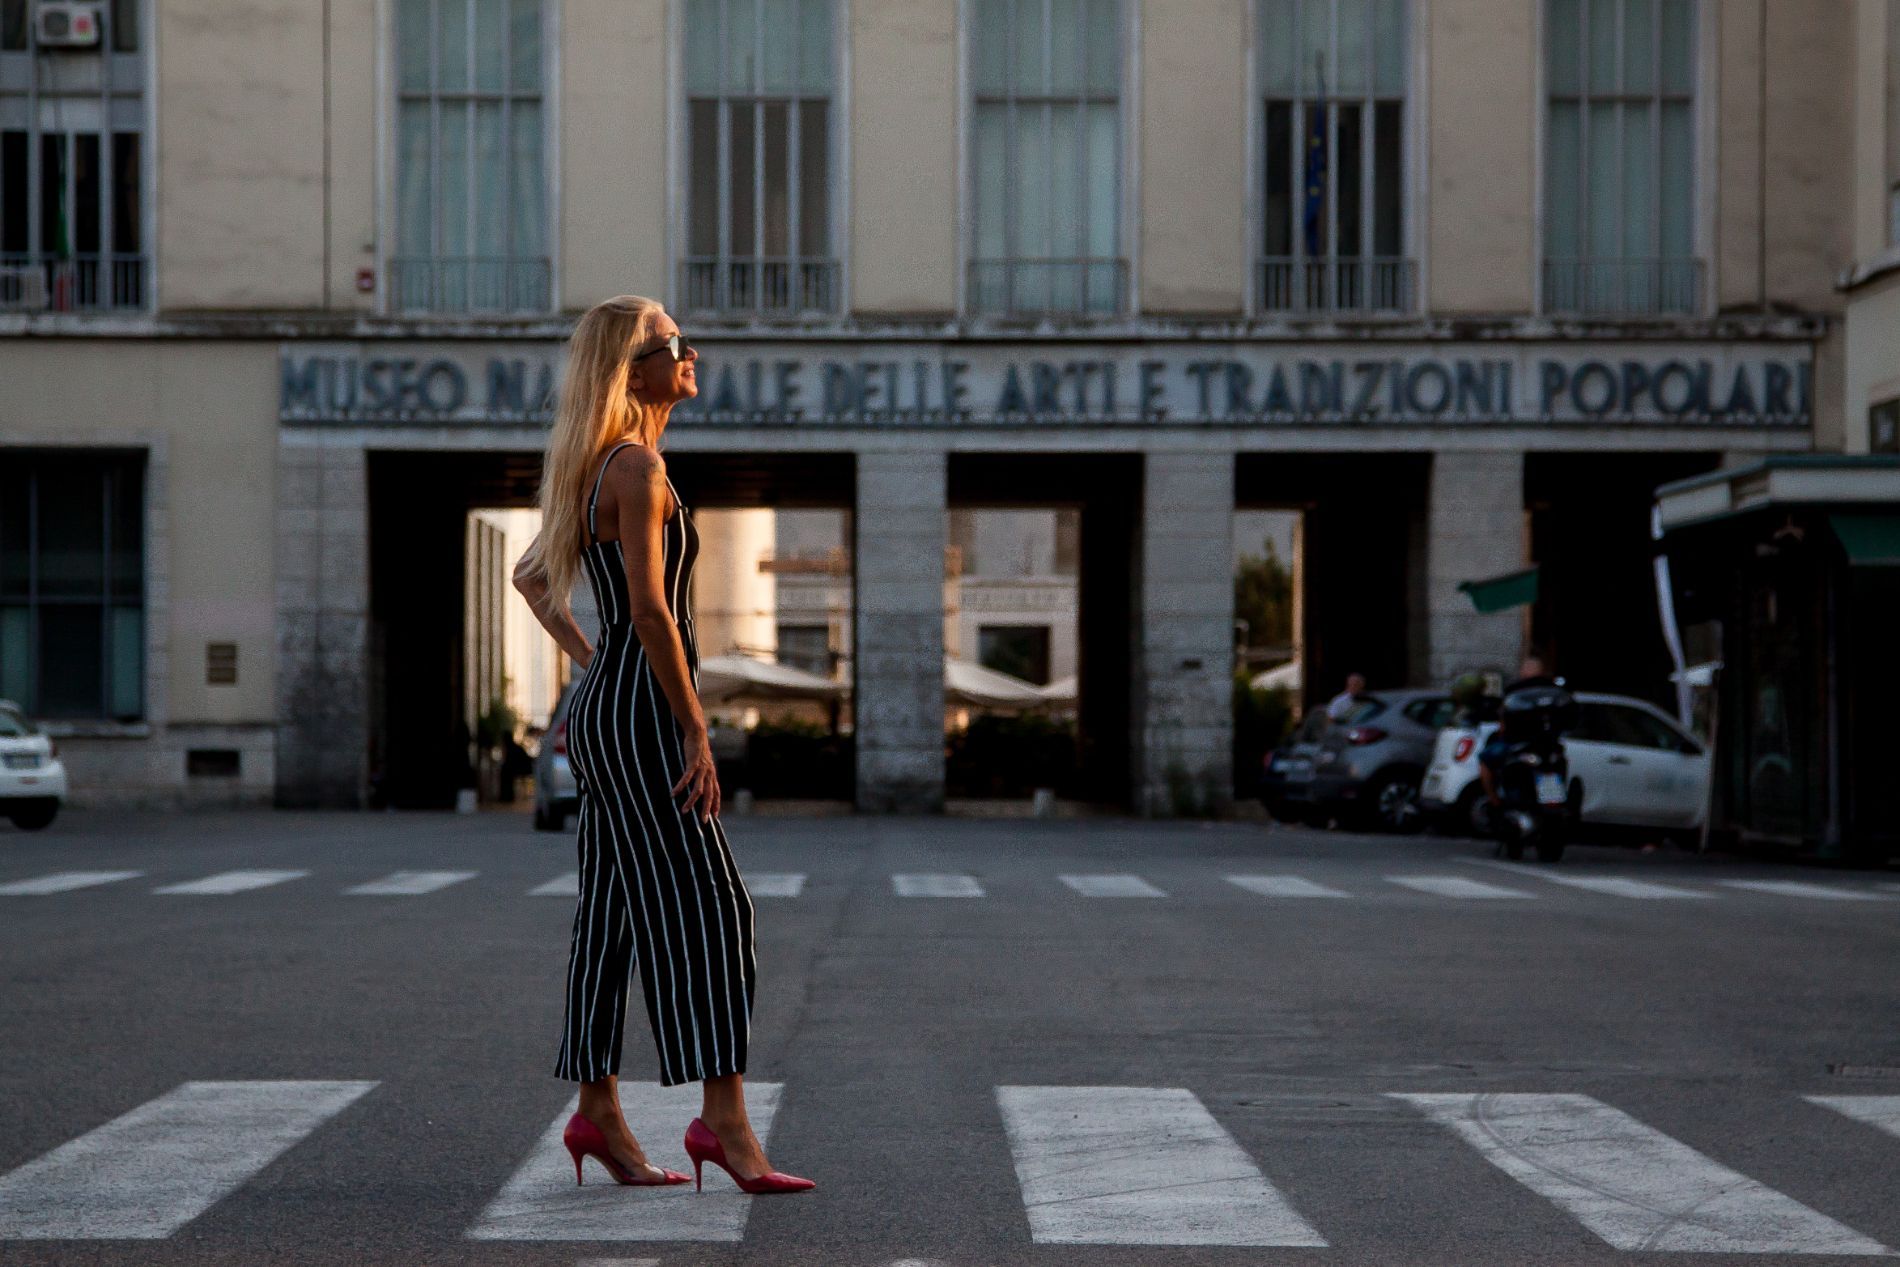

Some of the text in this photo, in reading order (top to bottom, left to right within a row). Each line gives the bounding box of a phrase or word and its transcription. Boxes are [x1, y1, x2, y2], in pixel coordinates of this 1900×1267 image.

[280, 358, 1811, 417] MUSEO NAALE DELLE ARTI E TRADIZIONI POPOLARI
